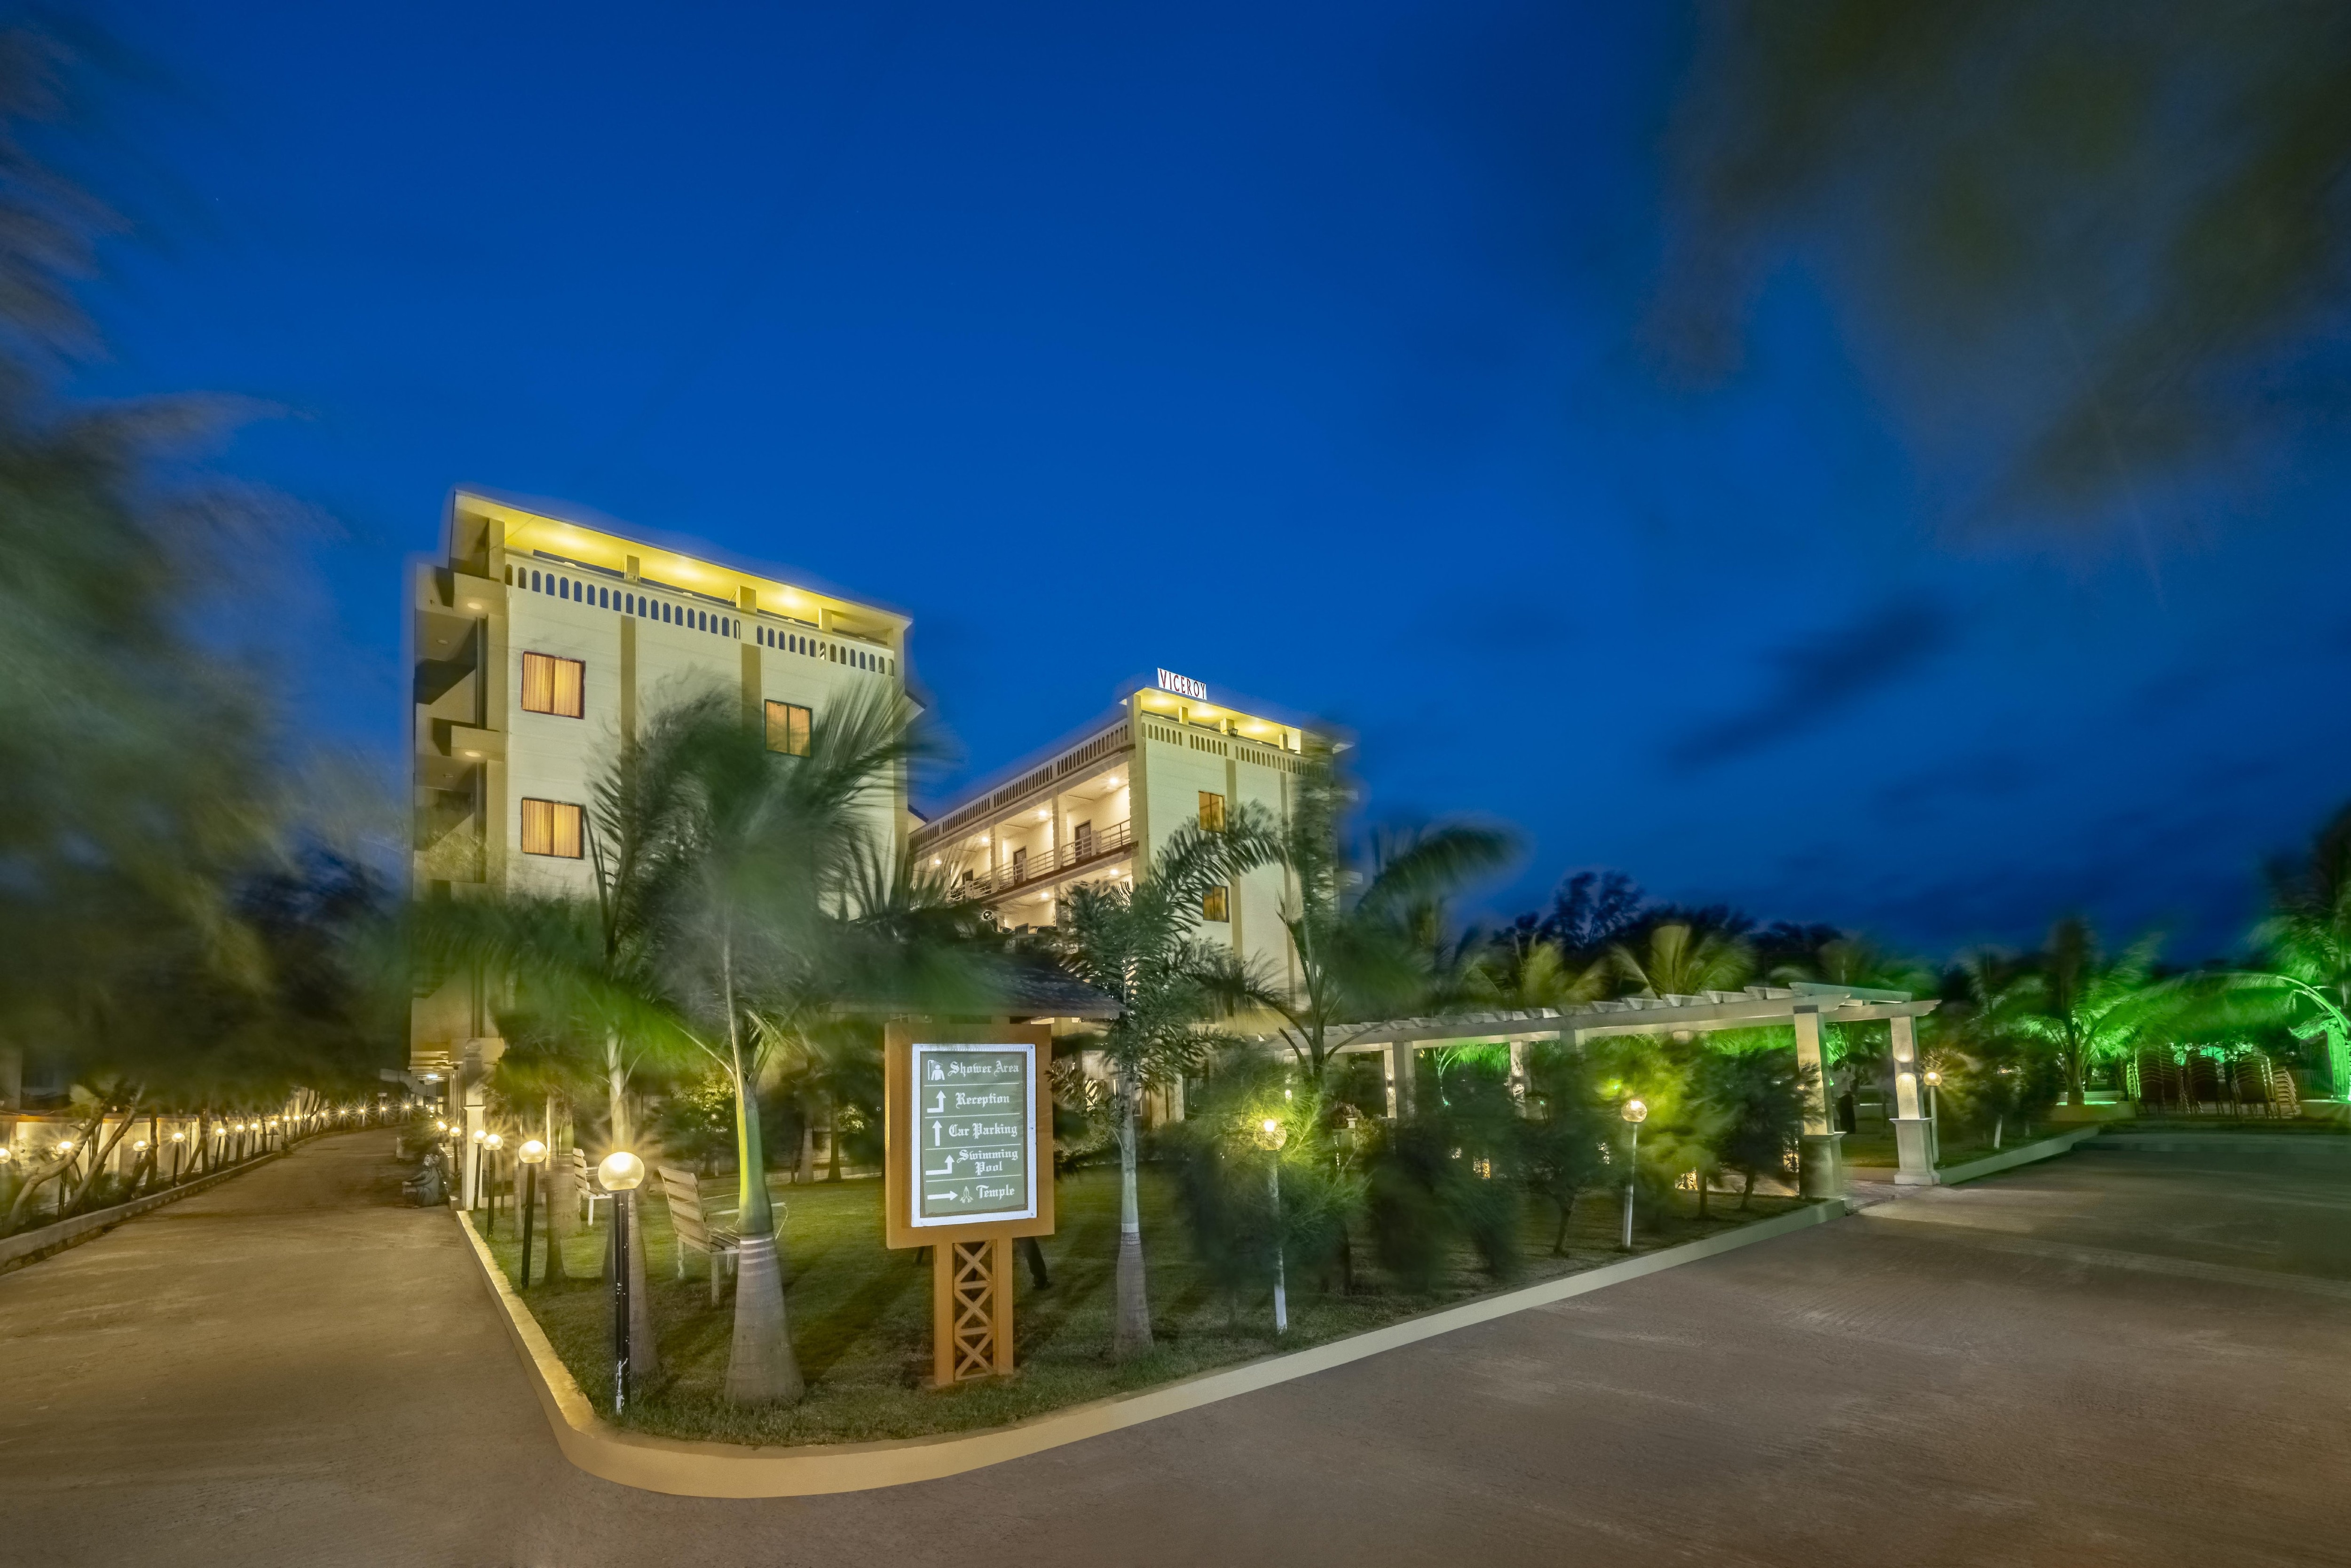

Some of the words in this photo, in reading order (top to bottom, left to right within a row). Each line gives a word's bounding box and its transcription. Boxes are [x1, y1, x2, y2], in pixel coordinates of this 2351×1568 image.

[1160, 669, 1205, 699] VICEROY
[947, 1062, 992, 1077] Shower
[993, 1060, 1019, 1077] Area
[955, 1092, 1010, 1109] Reception
[948, 1124, 970, 1137] Car
[972, 1123, 1018, 1139] Parking
[956, 1149, 1018, 1164] Swimming
[975, 1161, 1003, 1176] Pool
[976, 1184, 1015, 1200] Temple
